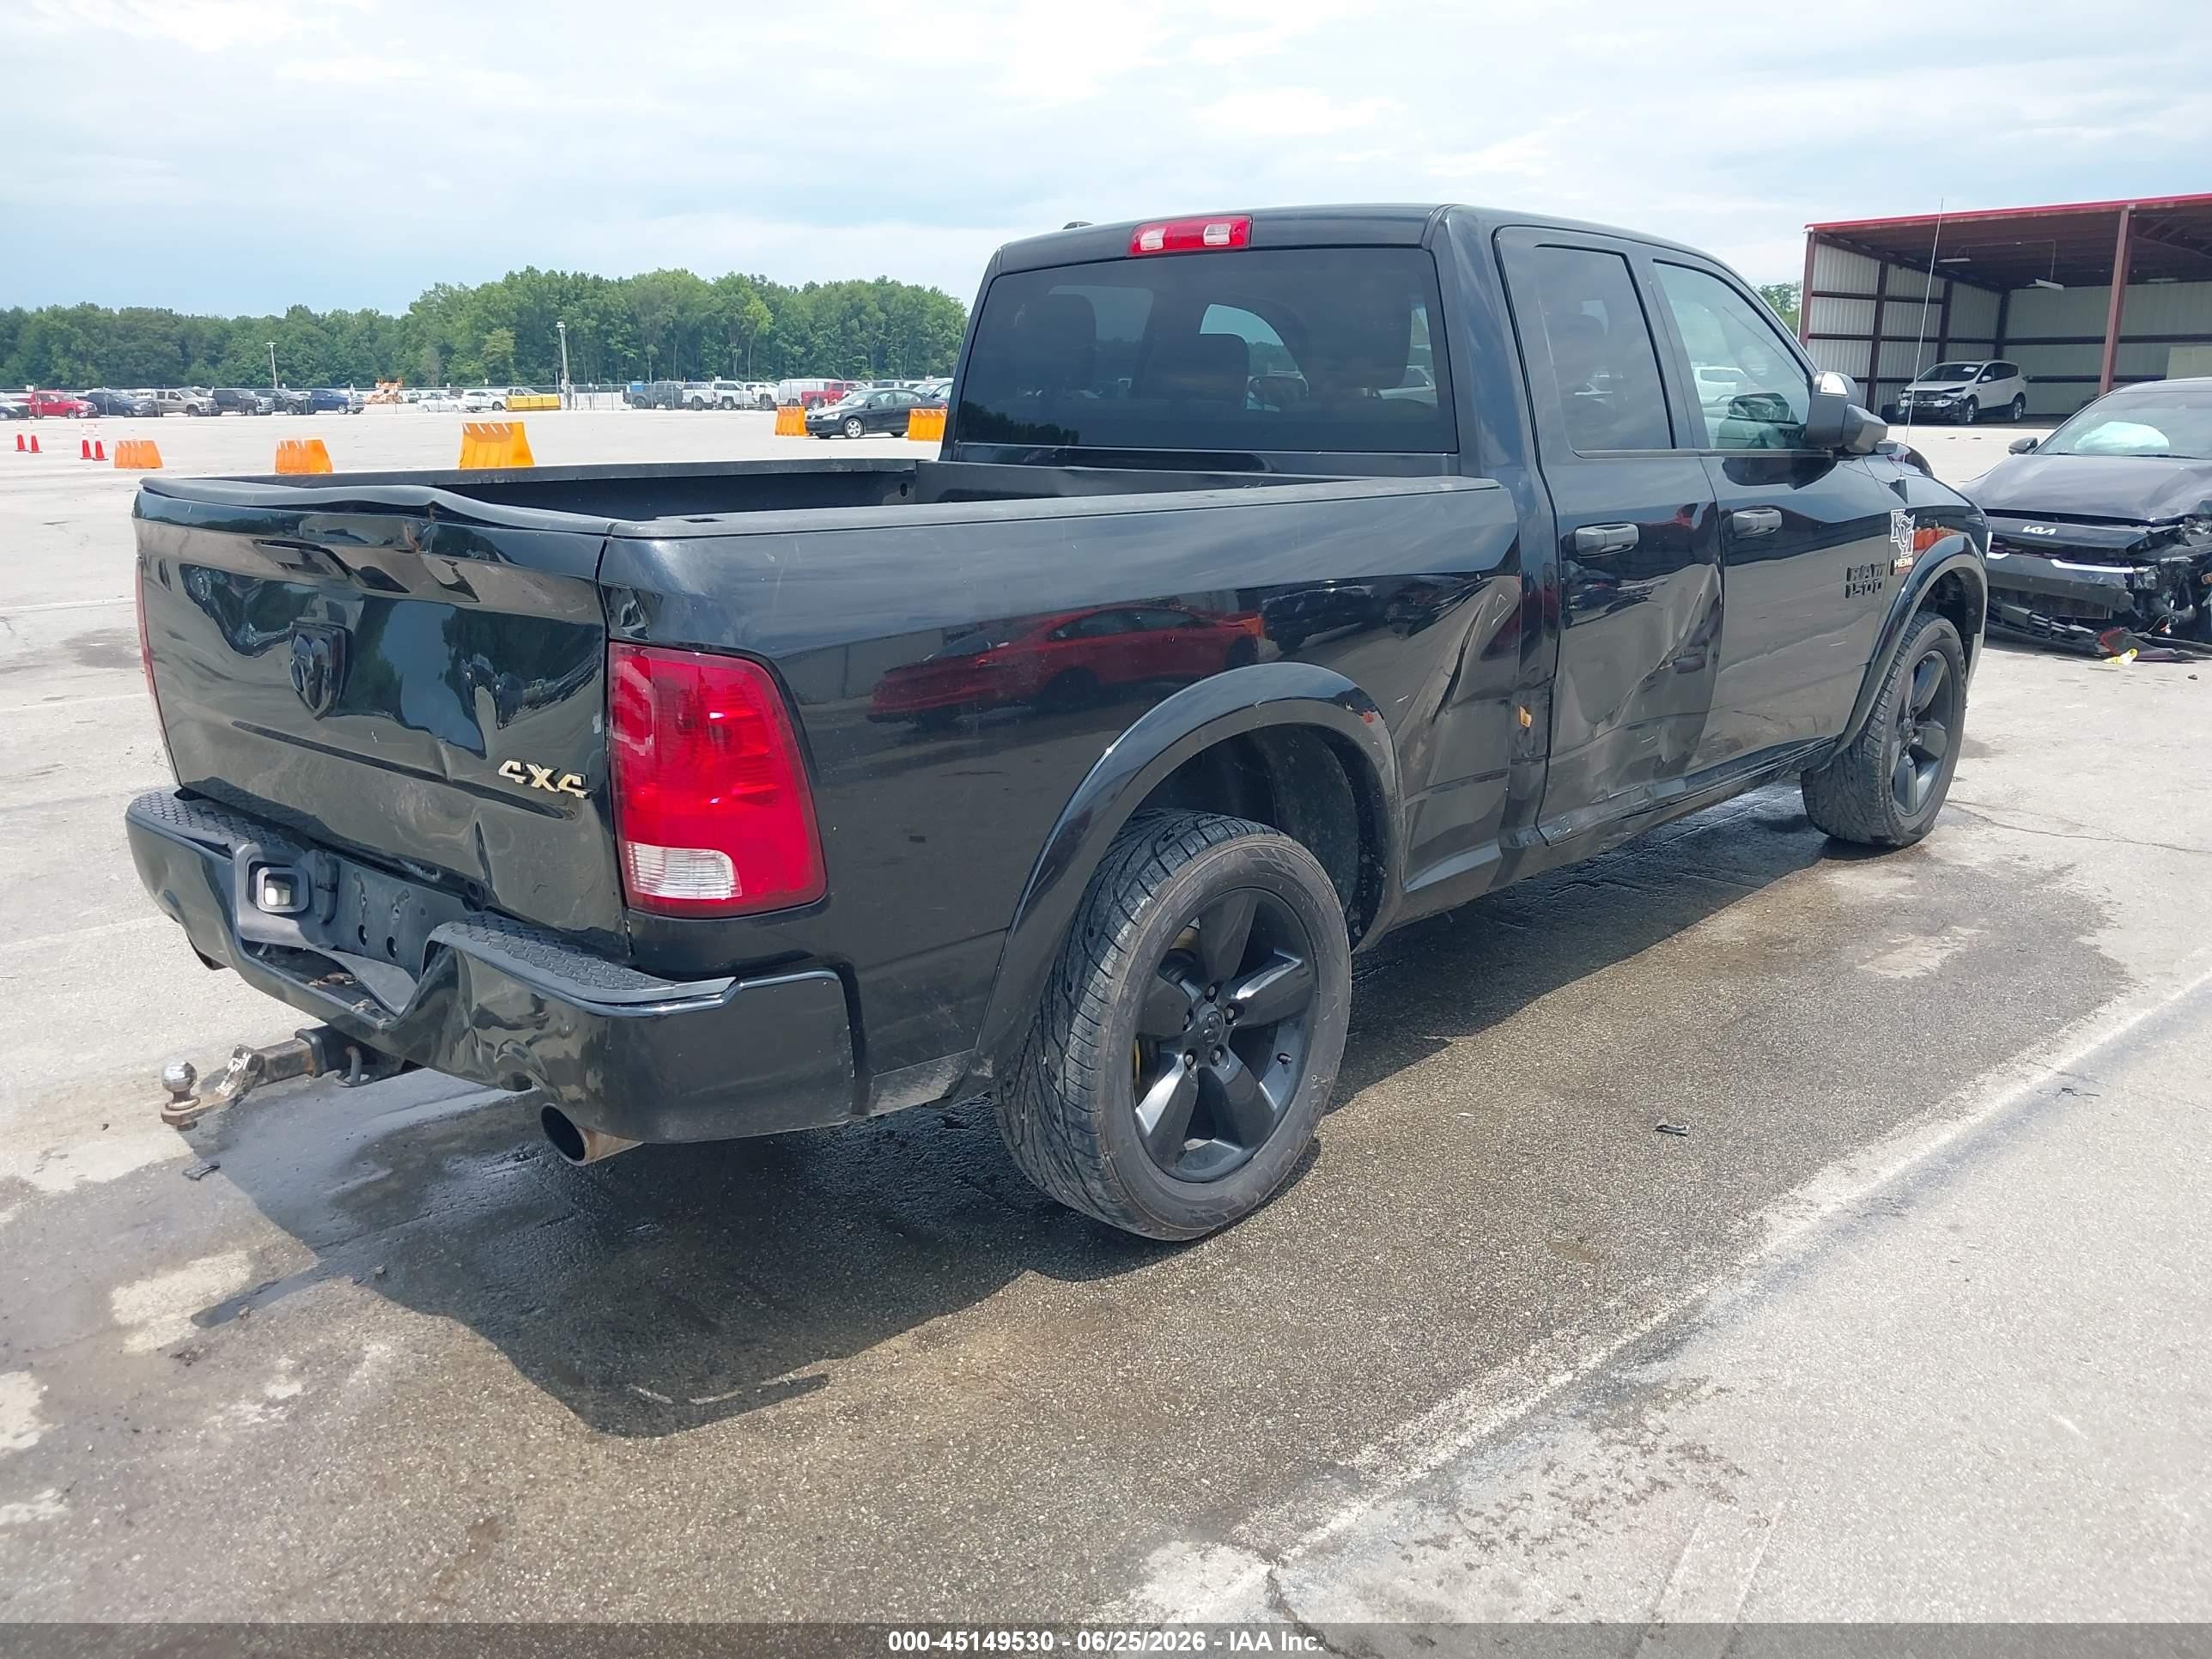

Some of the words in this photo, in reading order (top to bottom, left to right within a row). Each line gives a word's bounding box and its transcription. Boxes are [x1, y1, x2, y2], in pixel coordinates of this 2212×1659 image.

[1894, 557, 1913, 568] HEMI
[1846, 563, 1886, 581] RAM
[1845, 579, 1882, 599] 1500
